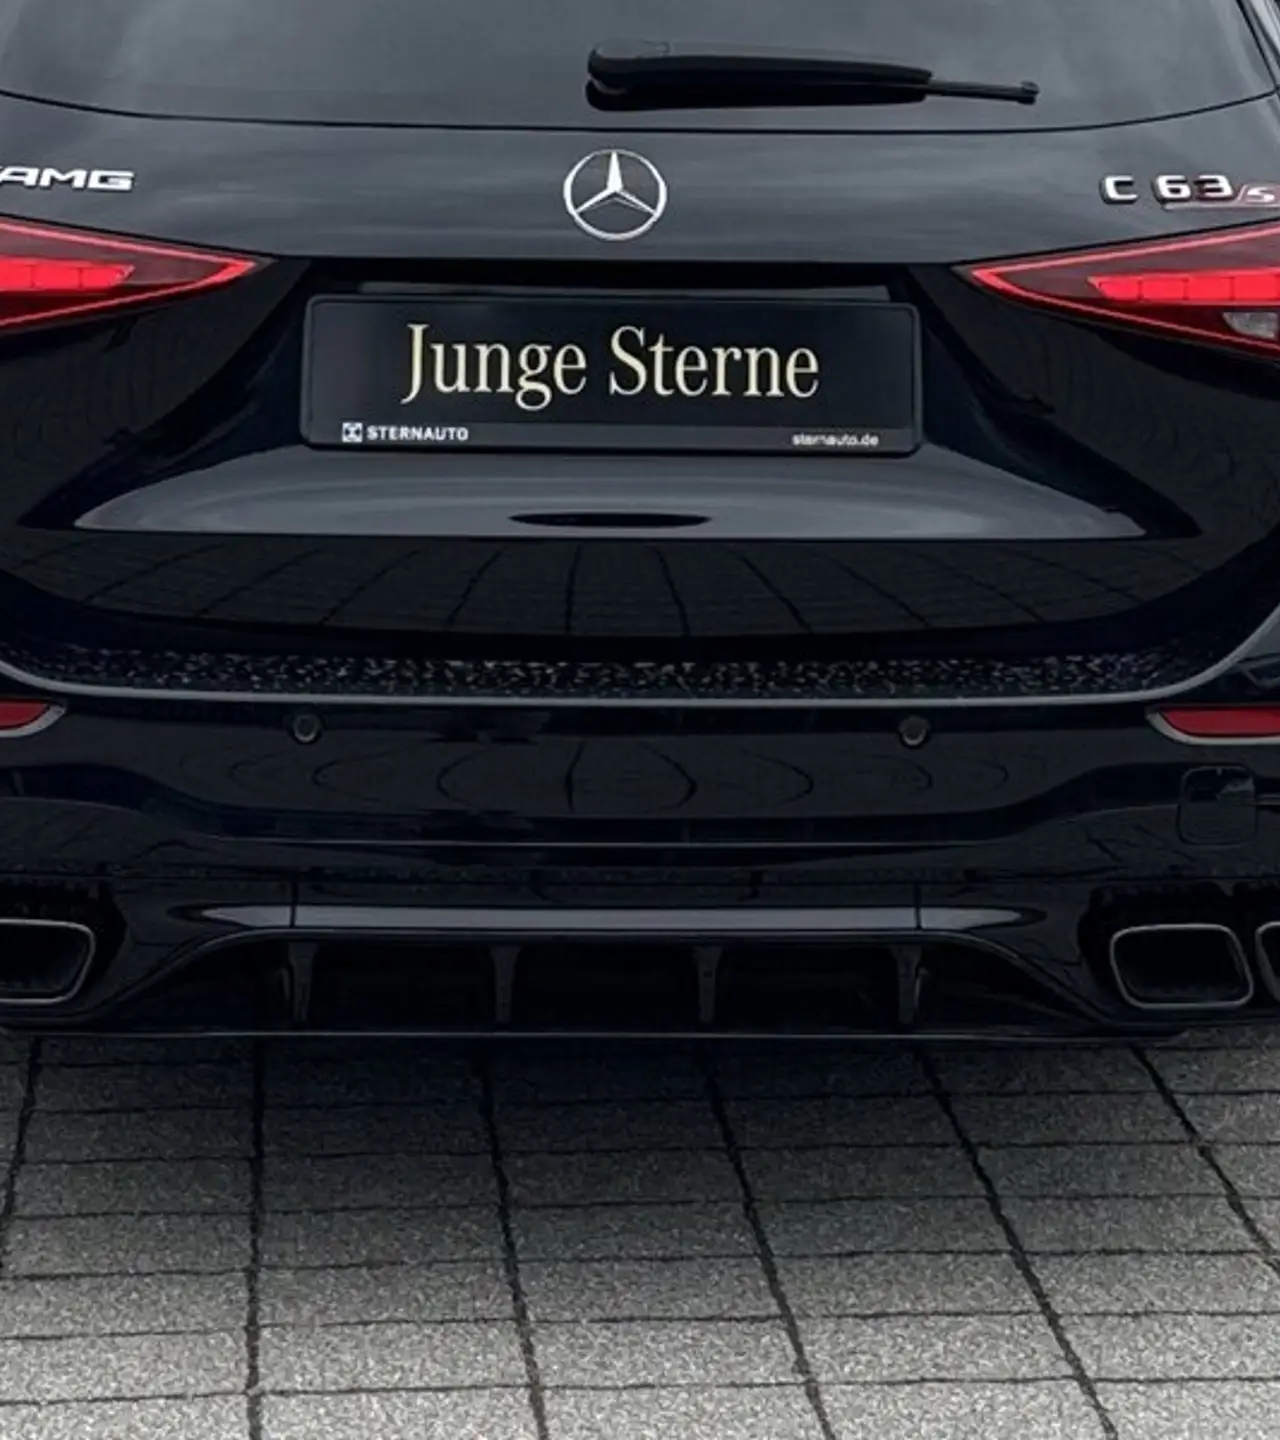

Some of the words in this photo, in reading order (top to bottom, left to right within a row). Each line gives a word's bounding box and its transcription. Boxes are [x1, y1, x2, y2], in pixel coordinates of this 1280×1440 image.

[1101, 174, 1138, 203] C
[400, 323, 587, 411] Junge
[609, 325, 819, 398] Sterne
[366, 425, 469, 442] STERNAUTO
